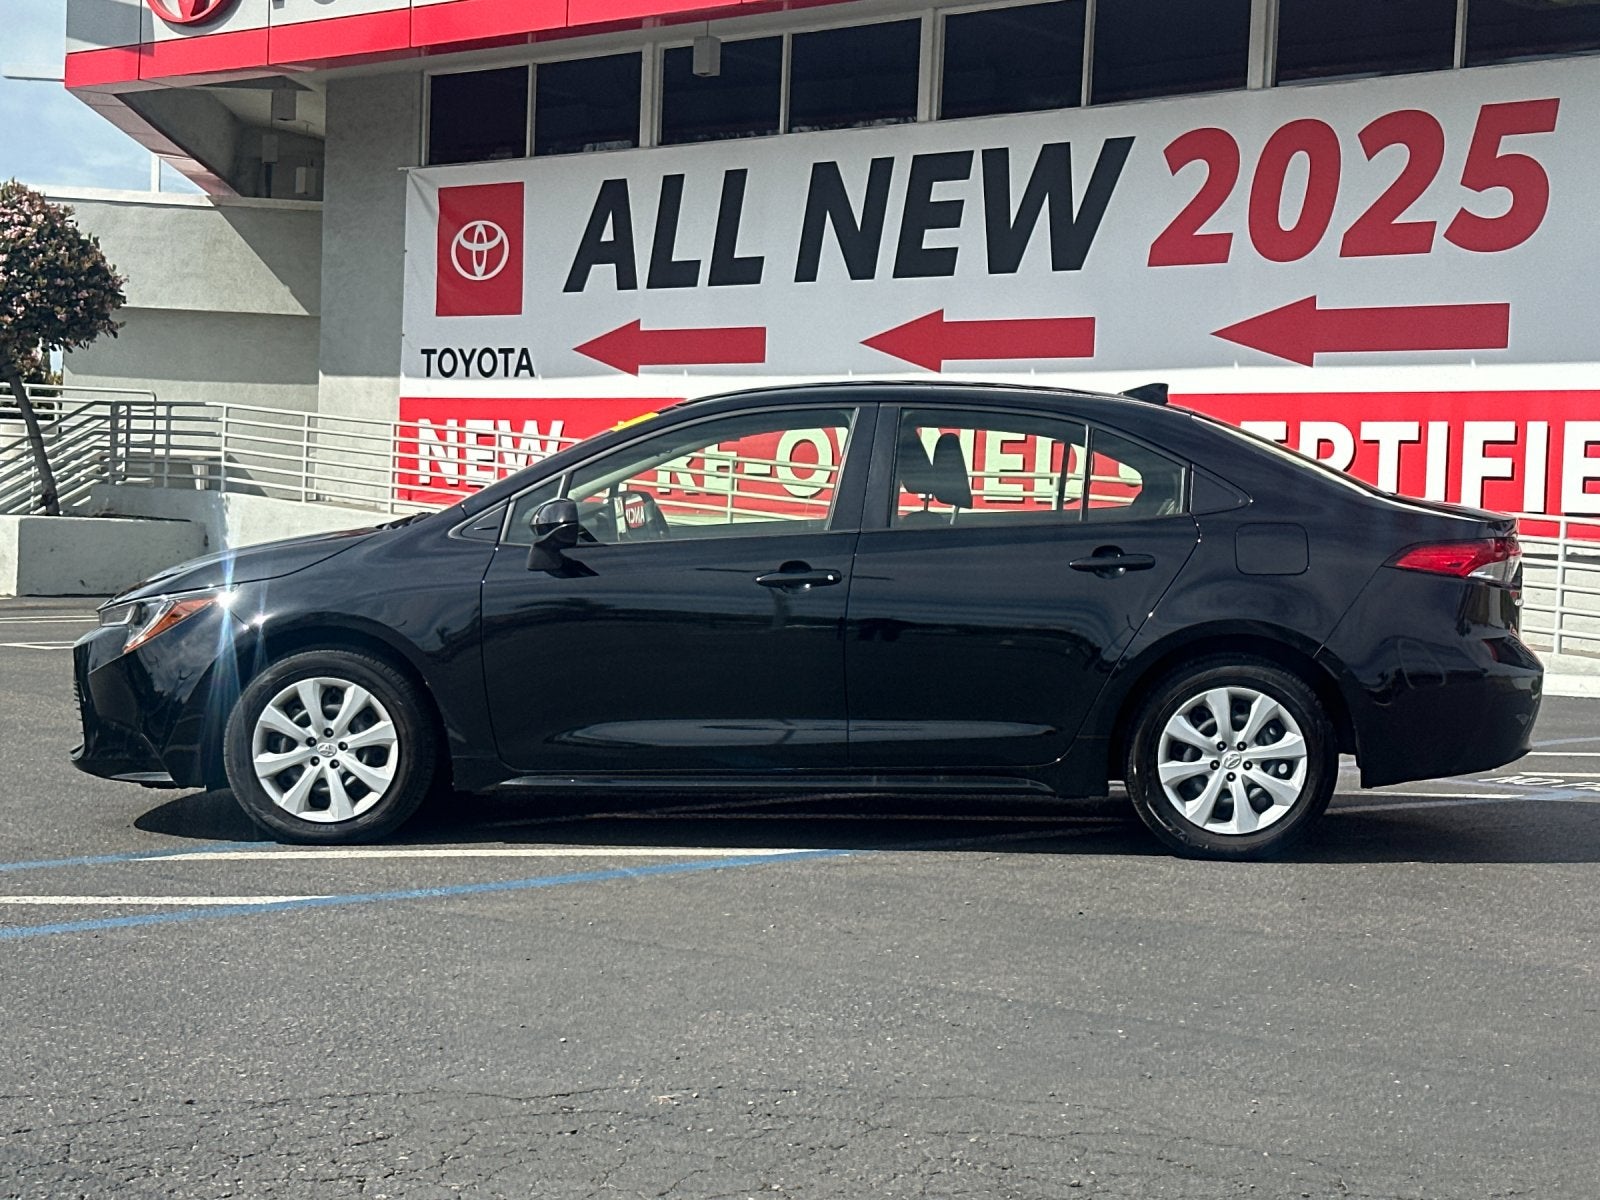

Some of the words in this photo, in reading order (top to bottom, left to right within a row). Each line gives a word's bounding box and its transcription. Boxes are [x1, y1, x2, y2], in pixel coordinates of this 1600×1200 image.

[563, 168, 765, 293] ALL
[794, 136, 1136, 283] NEW
[1147, 97, 1561, 268] 2025
[420, 346, 535, 379] TOYOTA
[418, 418, 565, 486] NEW
[1237, 420, 1600, 514] RTIFIE
